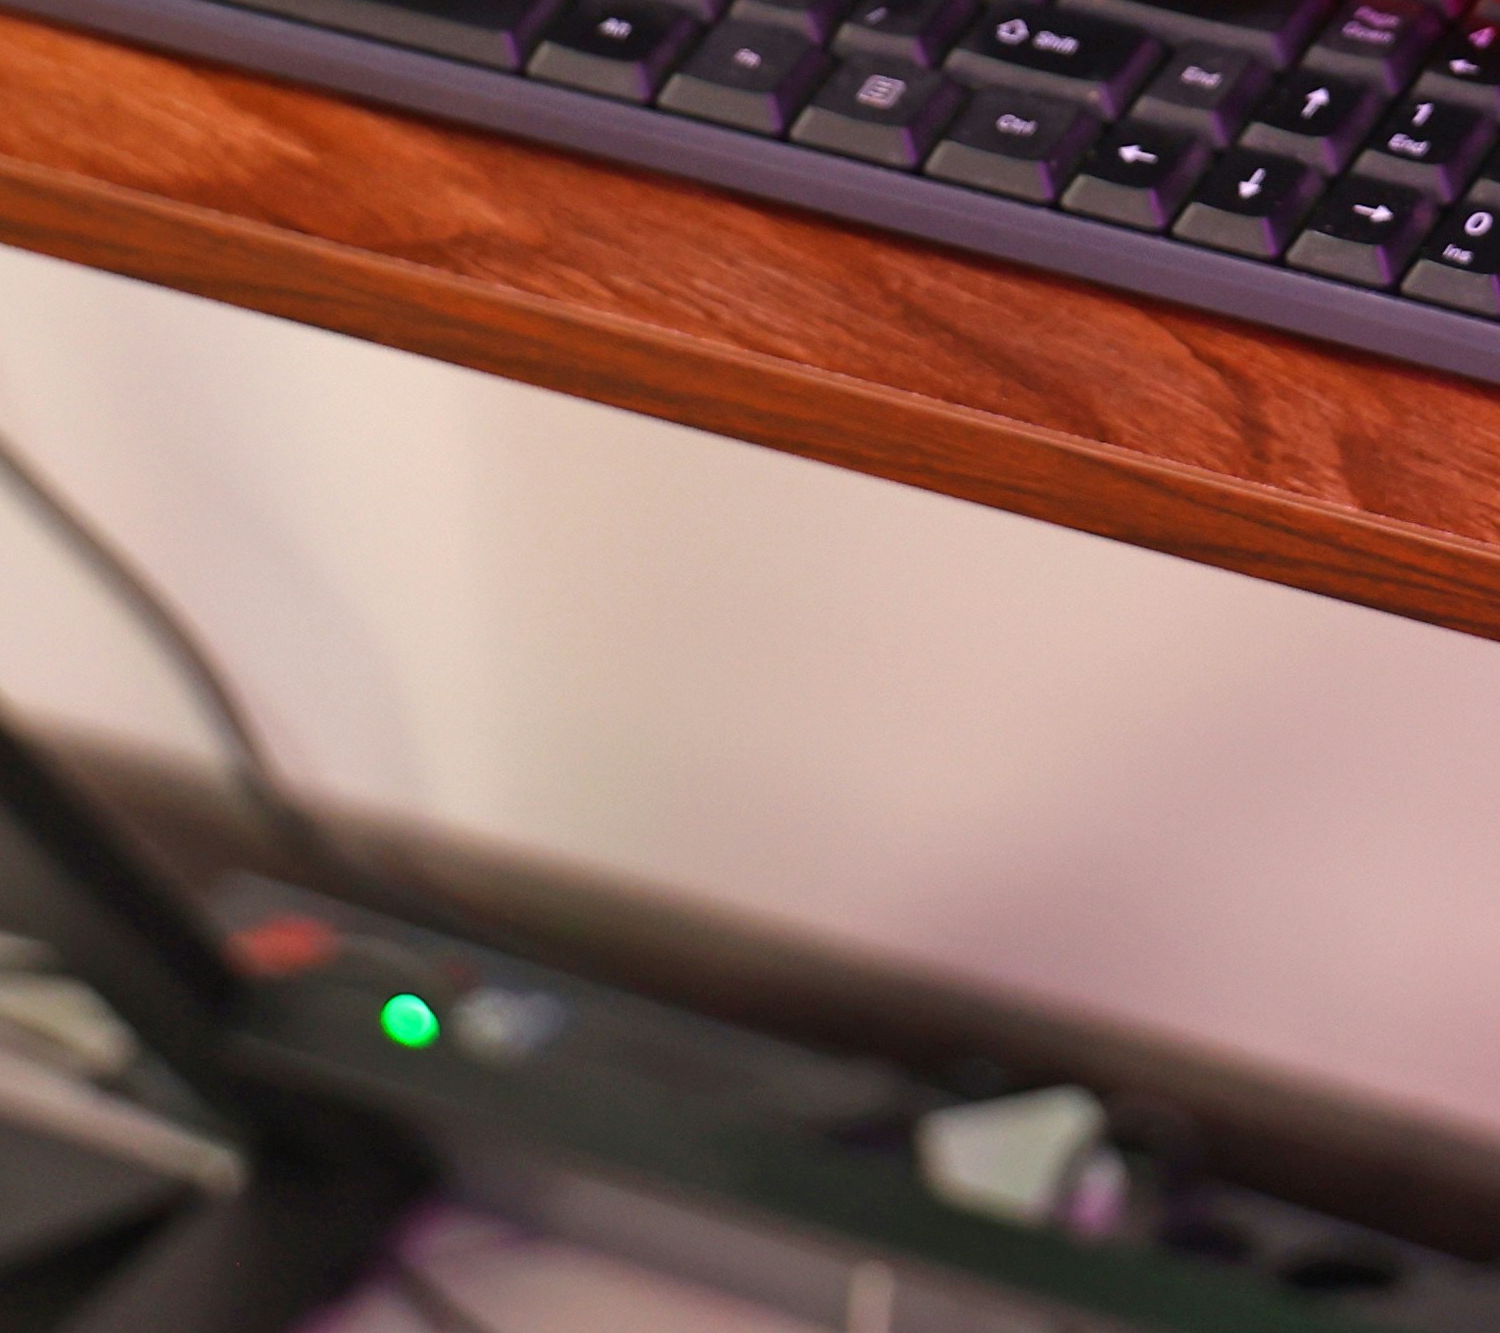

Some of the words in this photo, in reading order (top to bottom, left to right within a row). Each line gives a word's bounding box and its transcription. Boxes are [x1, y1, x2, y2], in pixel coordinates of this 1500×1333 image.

[1410, 101, 1436, 128] 1
[1463, 211, 1495, 237] 0
[1441, 242, 1476, 266] Ins
